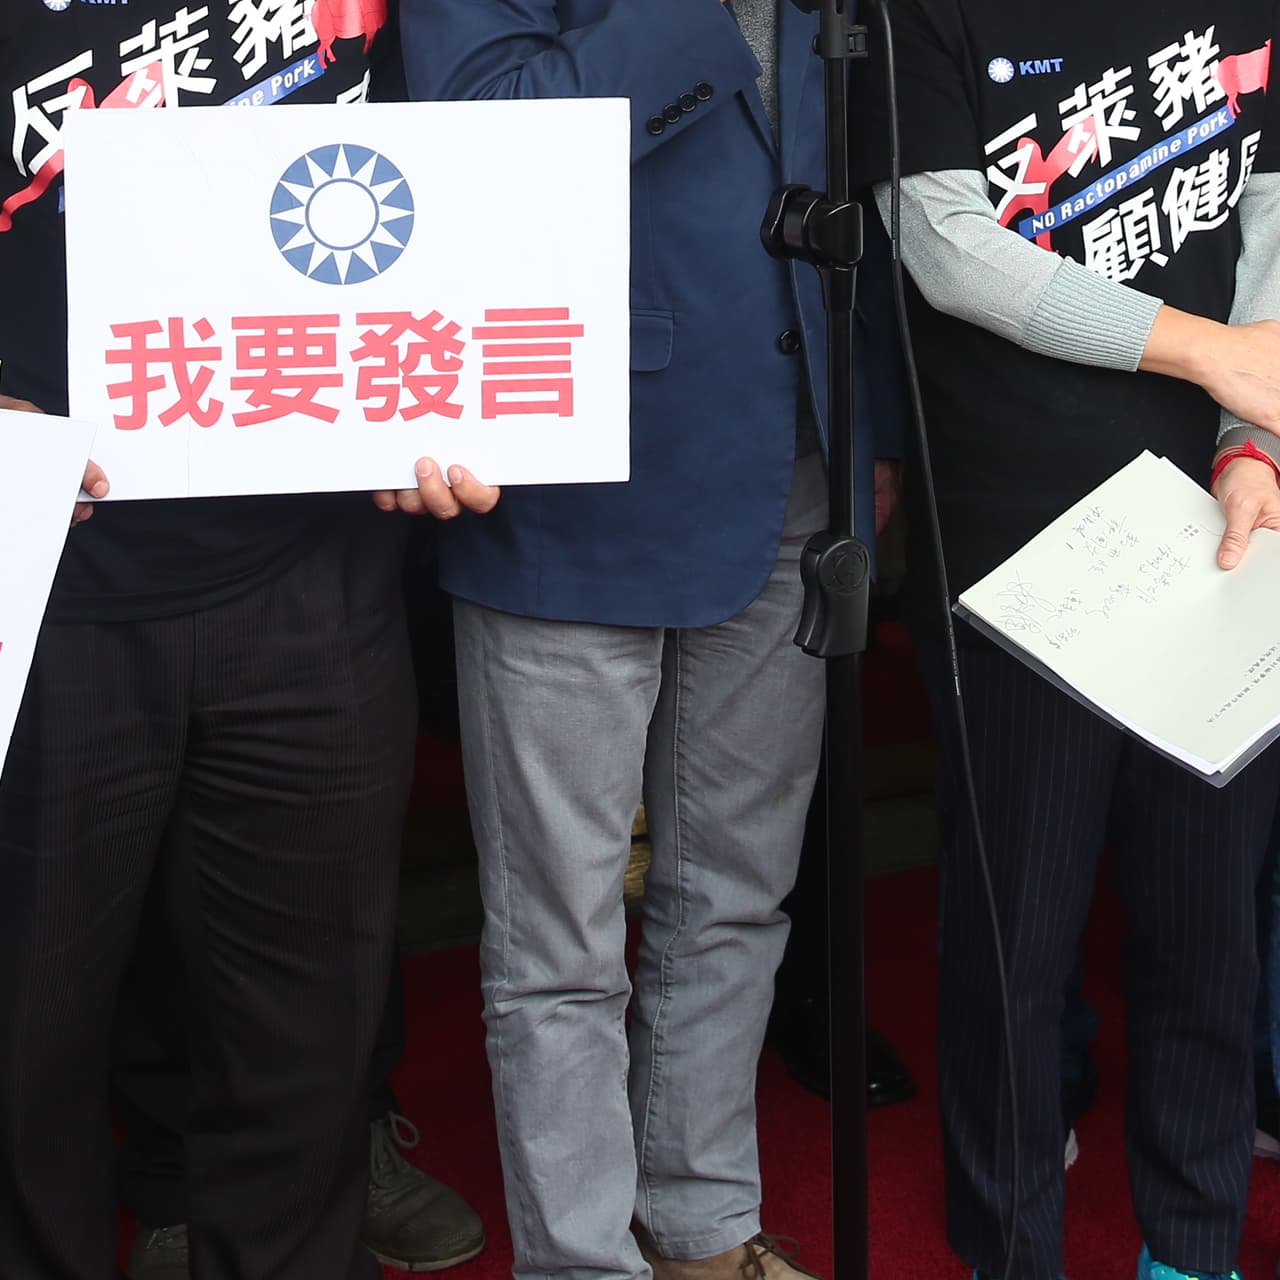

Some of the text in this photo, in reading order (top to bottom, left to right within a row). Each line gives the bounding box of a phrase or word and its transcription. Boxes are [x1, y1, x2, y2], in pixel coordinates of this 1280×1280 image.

[270, 58, 316, 97] Pork
[984, 24, 1228, 211] 反萊豬
[1020, 57, 1064, 75] KMT
[1031, 109, 1228, 234] NO Ractopamine Pork
[104, 306, 585, 431] 我要發言
